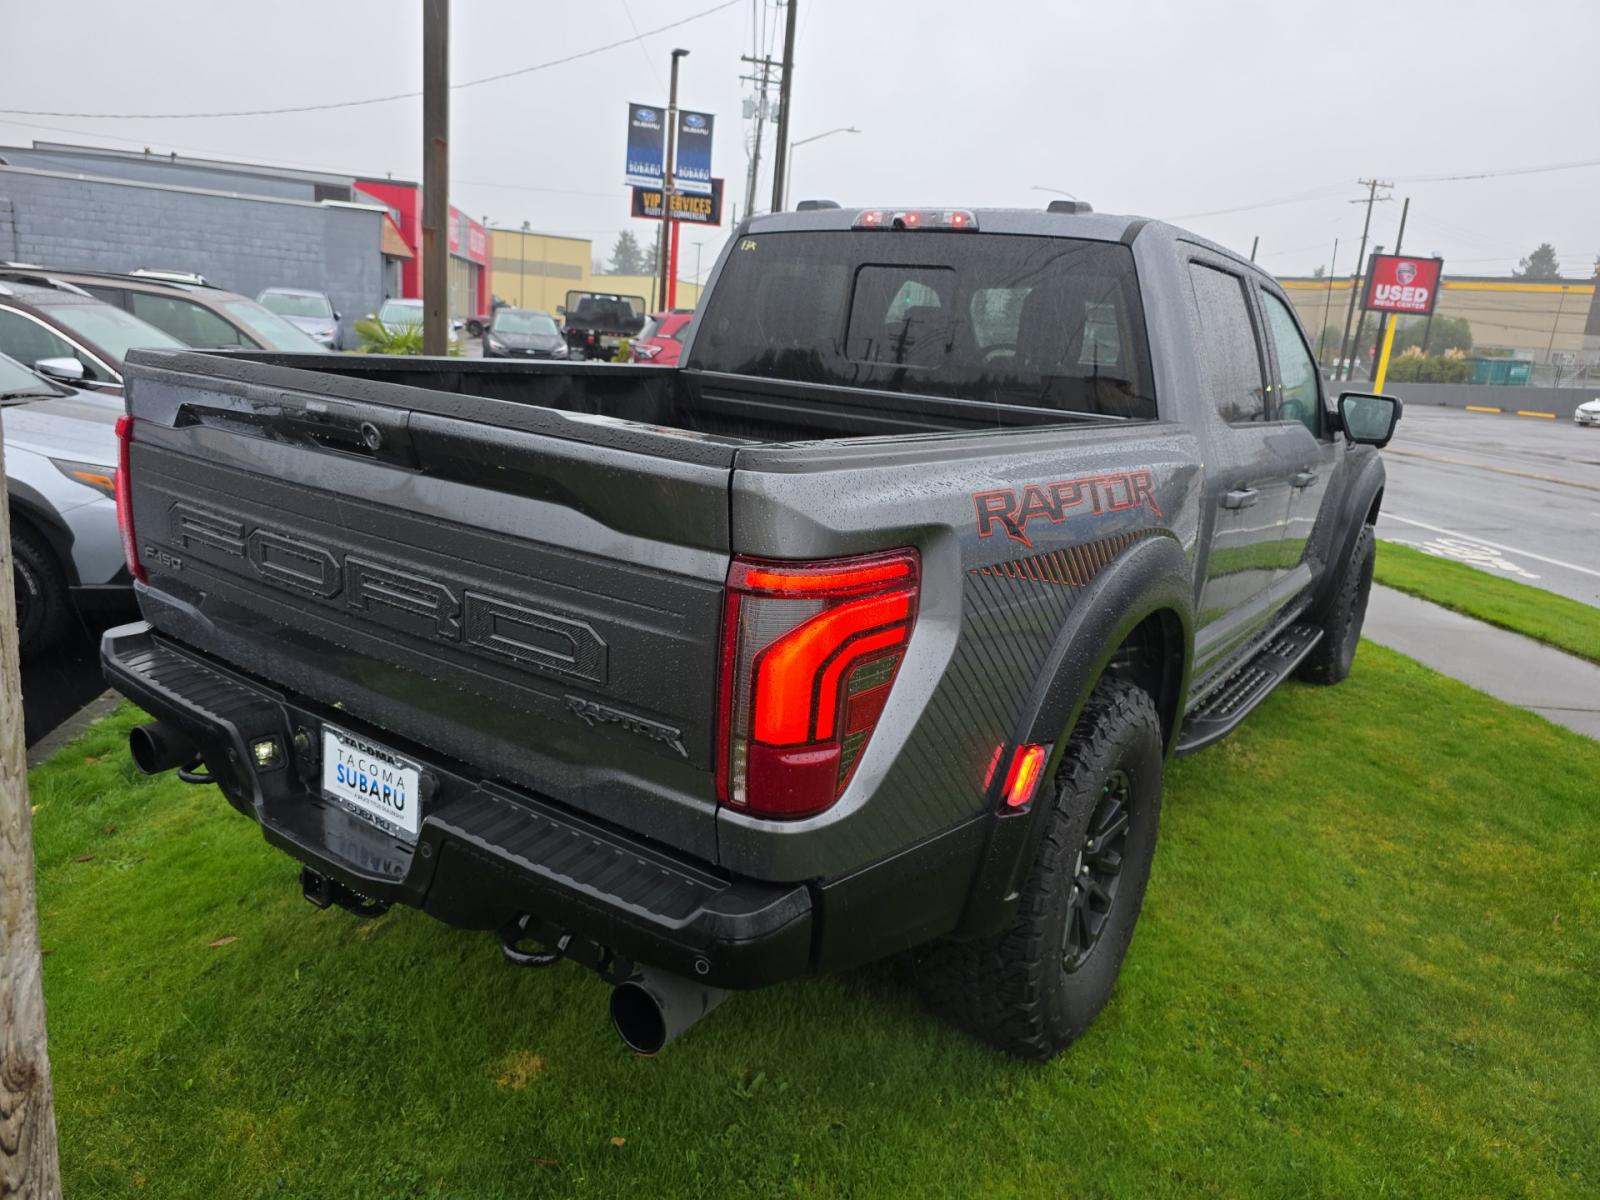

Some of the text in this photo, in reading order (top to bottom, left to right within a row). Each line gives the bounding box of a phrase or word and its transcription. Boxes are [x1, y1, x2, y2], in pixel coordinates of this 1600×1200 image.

[633, 120, 660, 130] SUBARU
[629, 163, 661, 176] SUBARU
[679, 168, 709, 180] SUBARU
[643, 192, 661, 208] VIP
[669, 194, 712, 215] ERVICES
[1375, 284, 1429, 303] USED
[1396, 301, 1425, 310] CENTER
[972, 470, 1164, 549] RAPTOR
[168, 500, 608, 685] FORD
[345, 739, 395, 765] TACOMA
[337, 749, 405, 789] TACOMA
[337, 763, 405, 811] SUBARU
[347, 802, 391, 830] SUBARU
